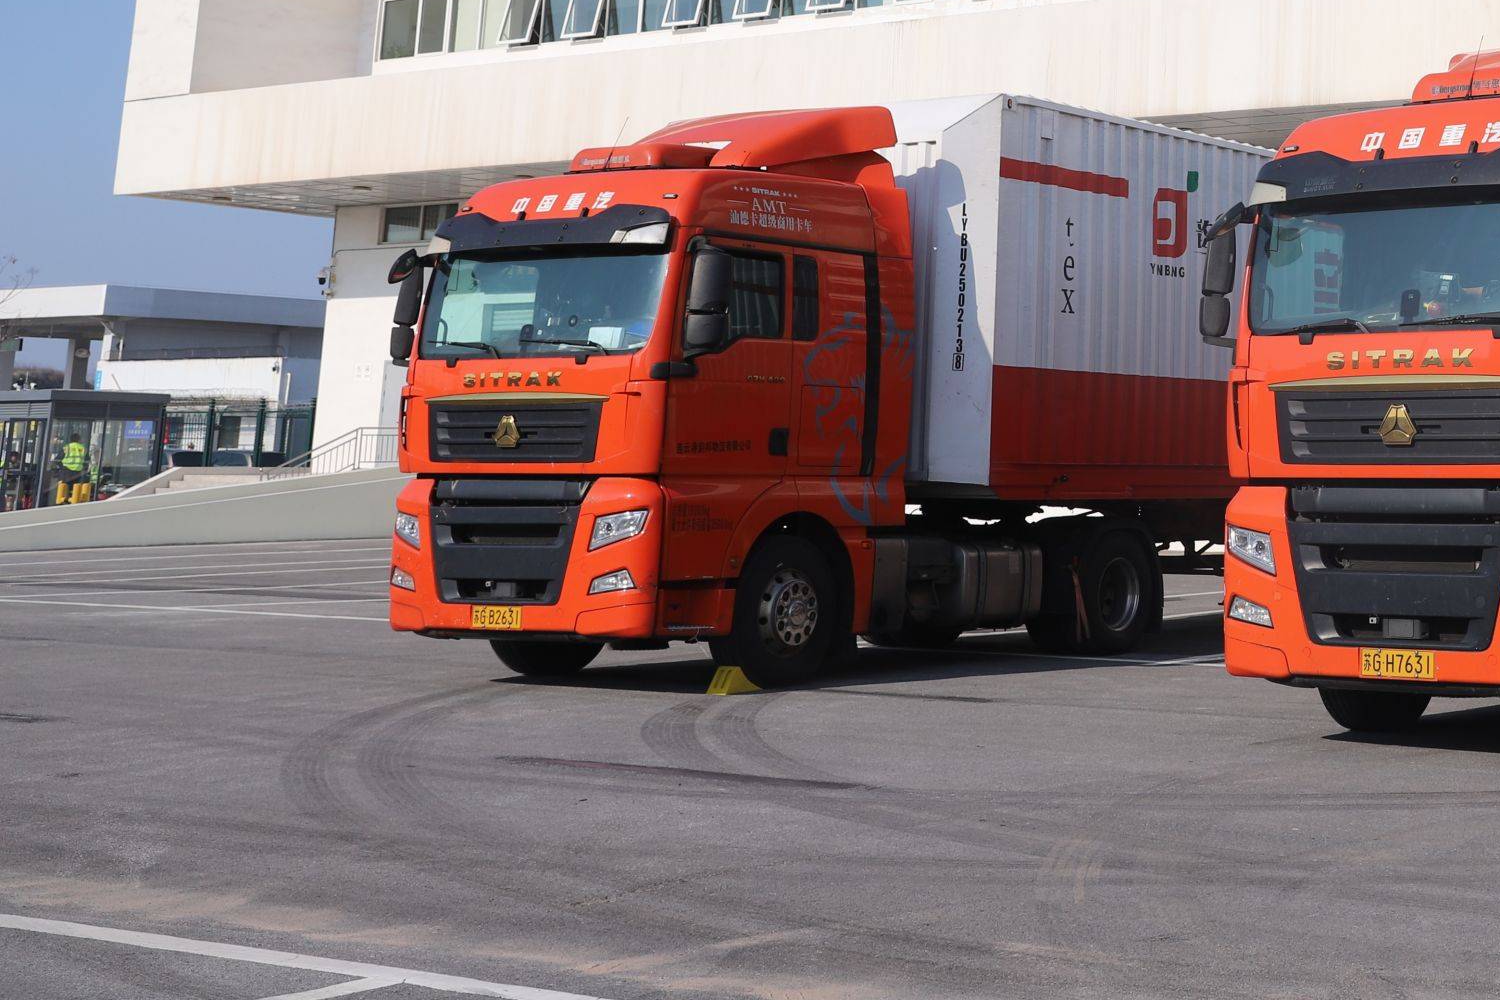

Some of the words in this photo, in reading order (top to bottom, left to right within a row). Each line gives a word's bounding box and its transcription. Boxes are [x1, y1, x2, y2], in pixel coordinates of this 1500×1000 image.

[752, 187, 780, 196] SITRAK
[511, 191, 615, 214] 中国重汽
[752, 197, 787, 215] AMT
[1326, 348, 1475, 370] SITRAK
[463, 371, 562, 388] SITRAK
